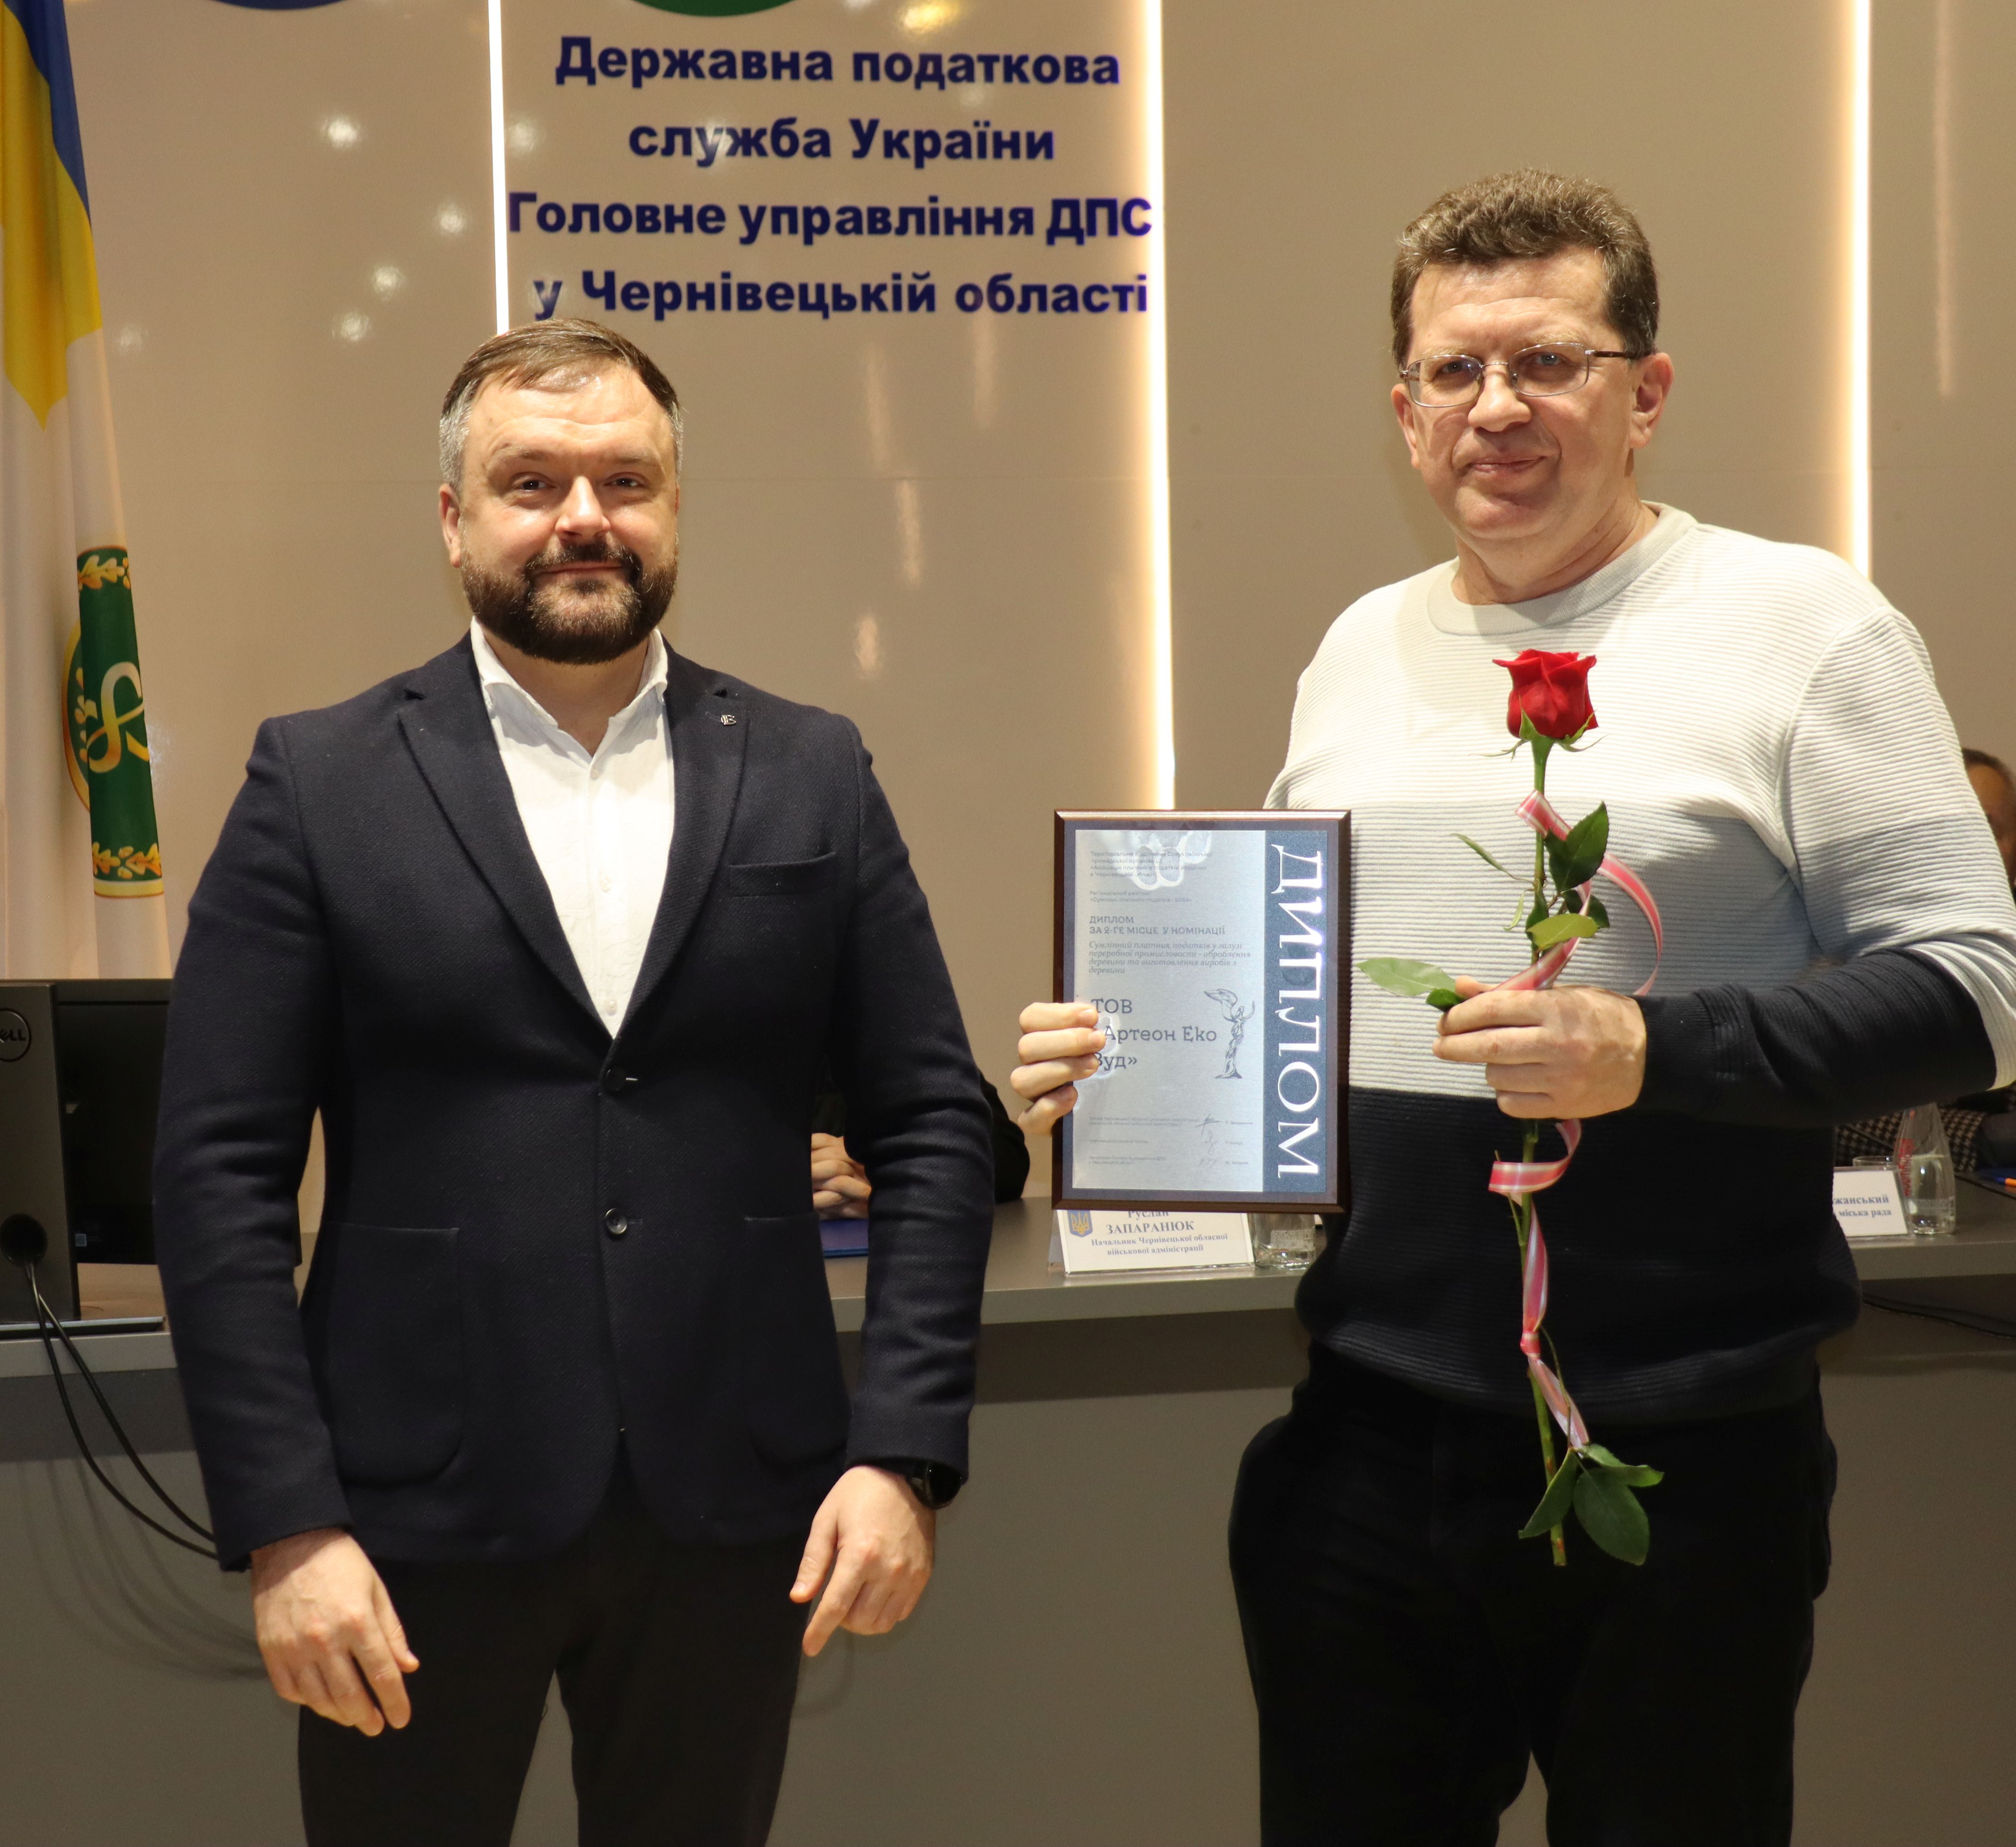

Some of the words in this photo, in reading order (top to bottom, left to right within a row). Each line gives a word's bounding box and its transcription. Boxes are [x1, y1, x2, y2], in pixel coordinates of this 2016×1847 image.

[555, 37, 833, 89] Державна
[853, 52, 1118, 90] податкова
[629, 117, 831, 167] служба
[850, 119, 1053, 169] України
[510, 192, 726, 235] Головне
[739, 196, 1034, 246] управління
[1046, 198, 1153, 247] ДПС
[535, 281, 562, 320] у
[582, 271, 935, 321] Чернівецькій
[956, 273, 1146, 313] області
[1172, 925, 1225, 935] НОМІНАЦІЇ
[1141, 959, 1198, 967] виготовлення
[1091, 998, 1132, 1014] ТОВ
[1270, 844, 1324, 1179] ДИПЛОМ
[0, 1029, 26, 1042] ELL
[1105, 1026, 1175, 1044] Артеон
[1182, 1025, 1217, 1042] Еко
[1833, 1194, 1889, 1204] жанський
[1128, 1211, 1168, 1220] Руслан
[1870, 1209, 1892, 1218] рада
[1106, 1221, 1194, 1234] ЗАПАРАНЮК
[1139, 1235, 1192, 1245] Чернівецької
[1152, 1245, 1204, 1253] адміністрації
